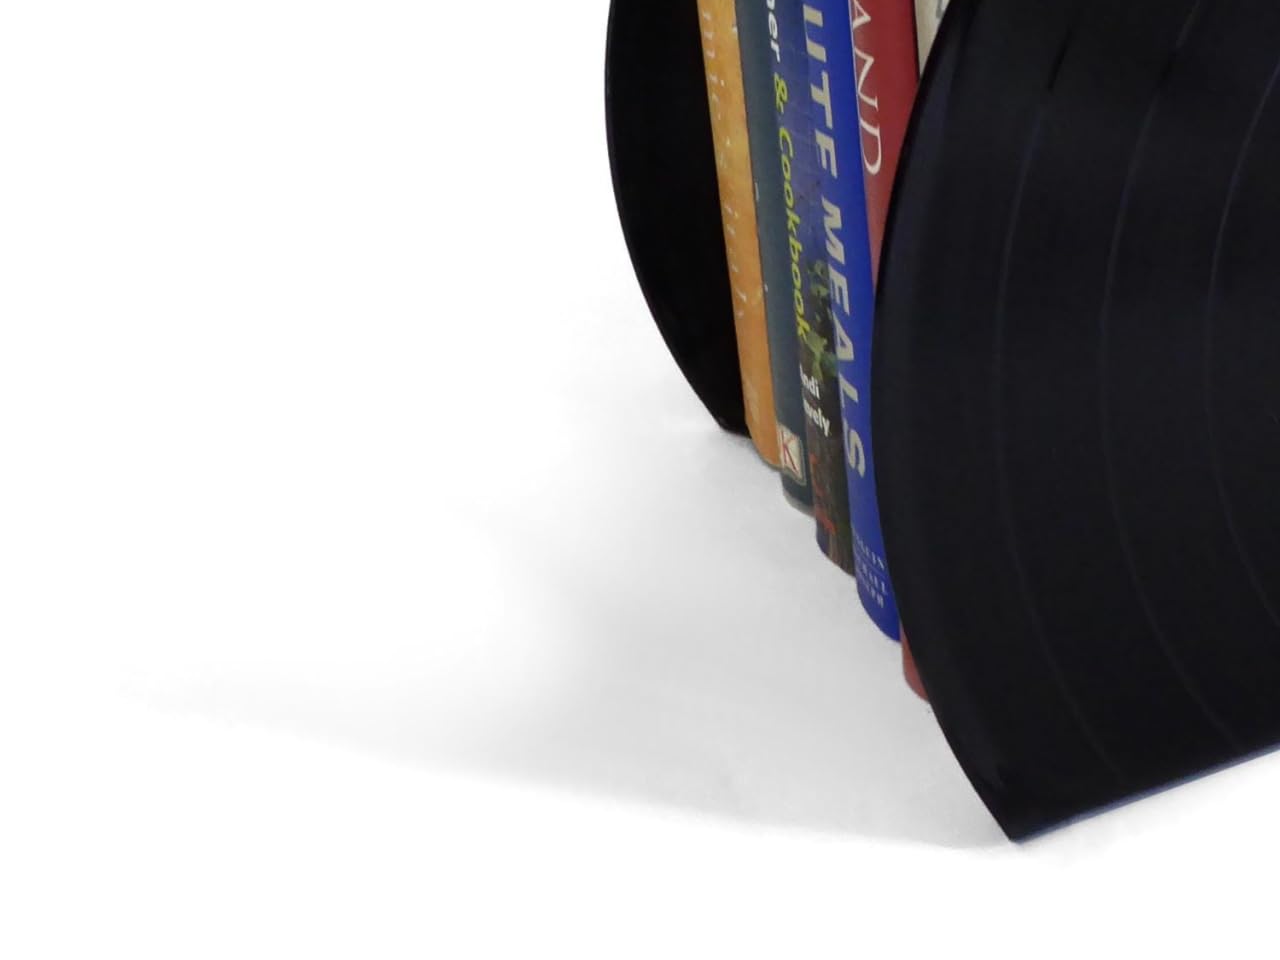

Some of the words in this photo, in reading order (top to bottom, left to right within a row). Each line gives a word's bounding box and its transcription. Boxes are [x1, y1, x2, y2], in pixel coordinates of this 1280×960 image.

[774, 72, 788, 115] &
[779, 125, 811, 342] Cookbook
[821, 193, 867, 479] MEALS
